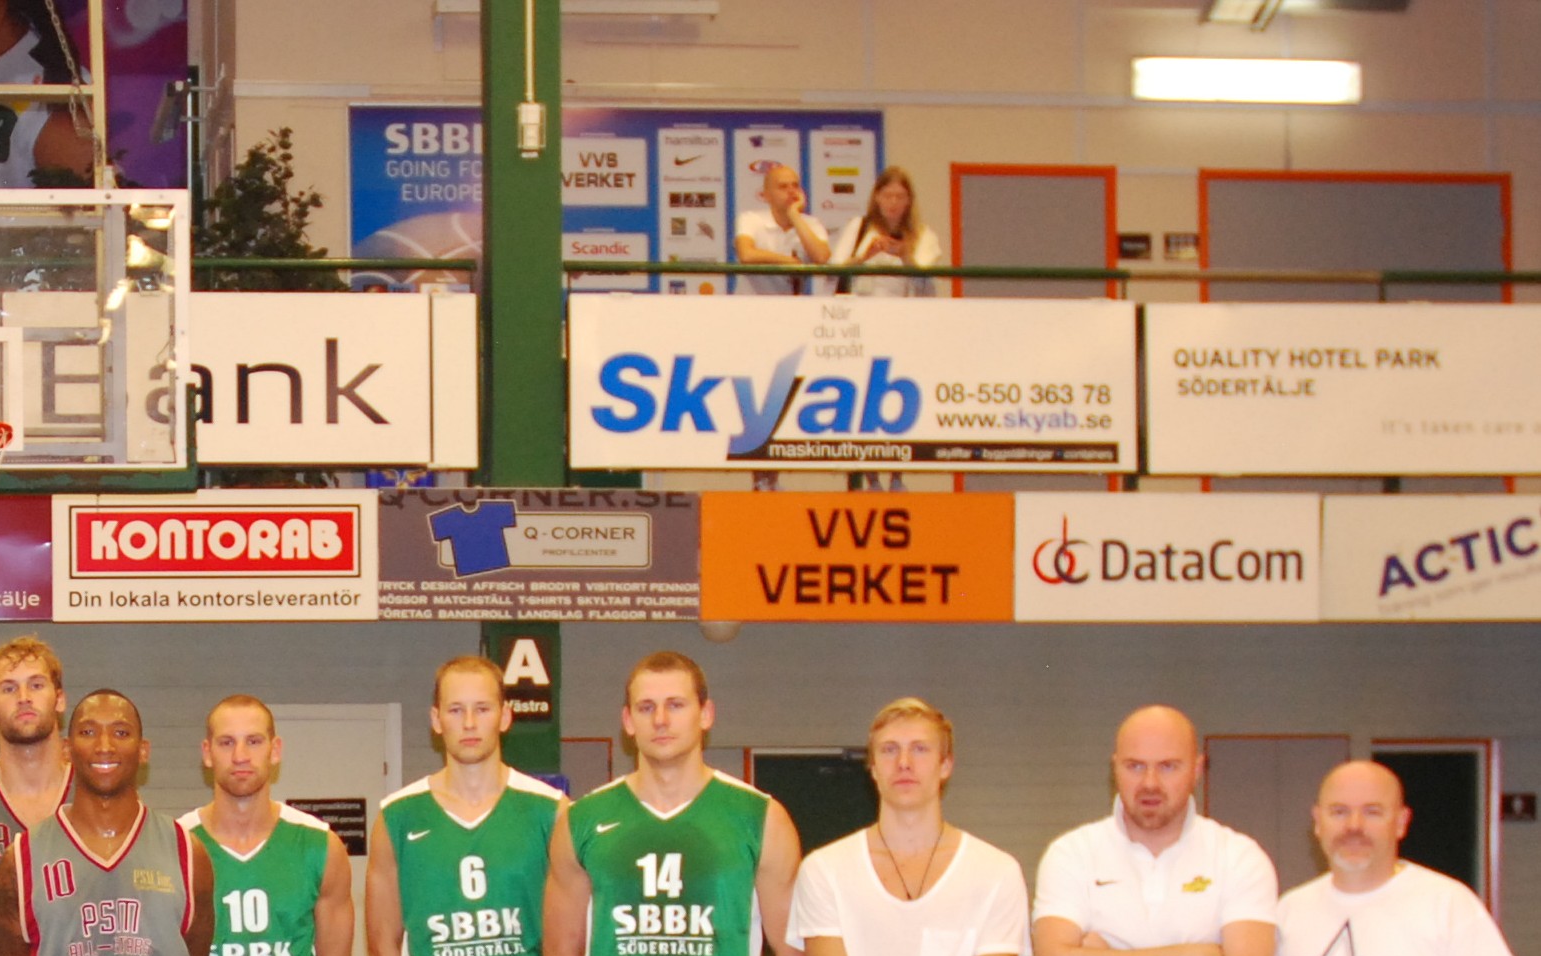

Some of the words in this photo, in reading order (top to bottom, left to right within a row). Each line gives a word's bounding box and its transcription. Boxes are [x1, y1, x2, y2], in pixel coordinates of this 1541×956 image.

[387, 160, 450, 178] GOING
[561, 172, 636, 188] VERKET
[571, 241, 630, 255] Scandic
[822, 304, 851, 320] När
[813, 324, 835, 339] du
[841, 323, 861, 339] vill
[815, 343, 864, 361] uppåt
[1174, 348, 1280, 370] QUALITY
[1290, 349, 1368, 370] HOTEL
[1376, 349, 1442, 370] PARK
[42, 337, 391, 425] Bank
[935, 383, 1022, 405] 08-550
[1030, 384, 1074, 405] 363
[1083, 384, 1112, 405] 78
[1178, 376, 1316, 397] SÖDERTÄLJE
[591, 344, 922, 455] Skyab
[936, 408, 1113, 433] www.skyab.se
[90, 519, 344, 561] KONTORAB
[807, 507, 912, 549] VVS
[1100, 538, 1304, 584] DataCom
[1379, 517, 1540, 598] ACTIC
[68, 590, 105, 608] Din
[111, 590, 170, 608] lokala
[177, 590, 362, 608] kontorsleverantör
[421, 581, 467, 591] DESIGN
[473, 582, 525, 591] AFFISCH
[757, 563, 960, 605] VERKET
[503, 638, 550, 686] A
[42, 858, 77, 902] 10
[460, 855, 488, 900] 6
[635, 852, 684, 898] 14
[80, 898, 142, 938] PSM
[222, 889, 269, 933] 10
[427, 907, 523, 943] SBBK
[612, 904, 715, 936] SBBK
[616, 940, 714, 956] SÖDERTÄLJE
